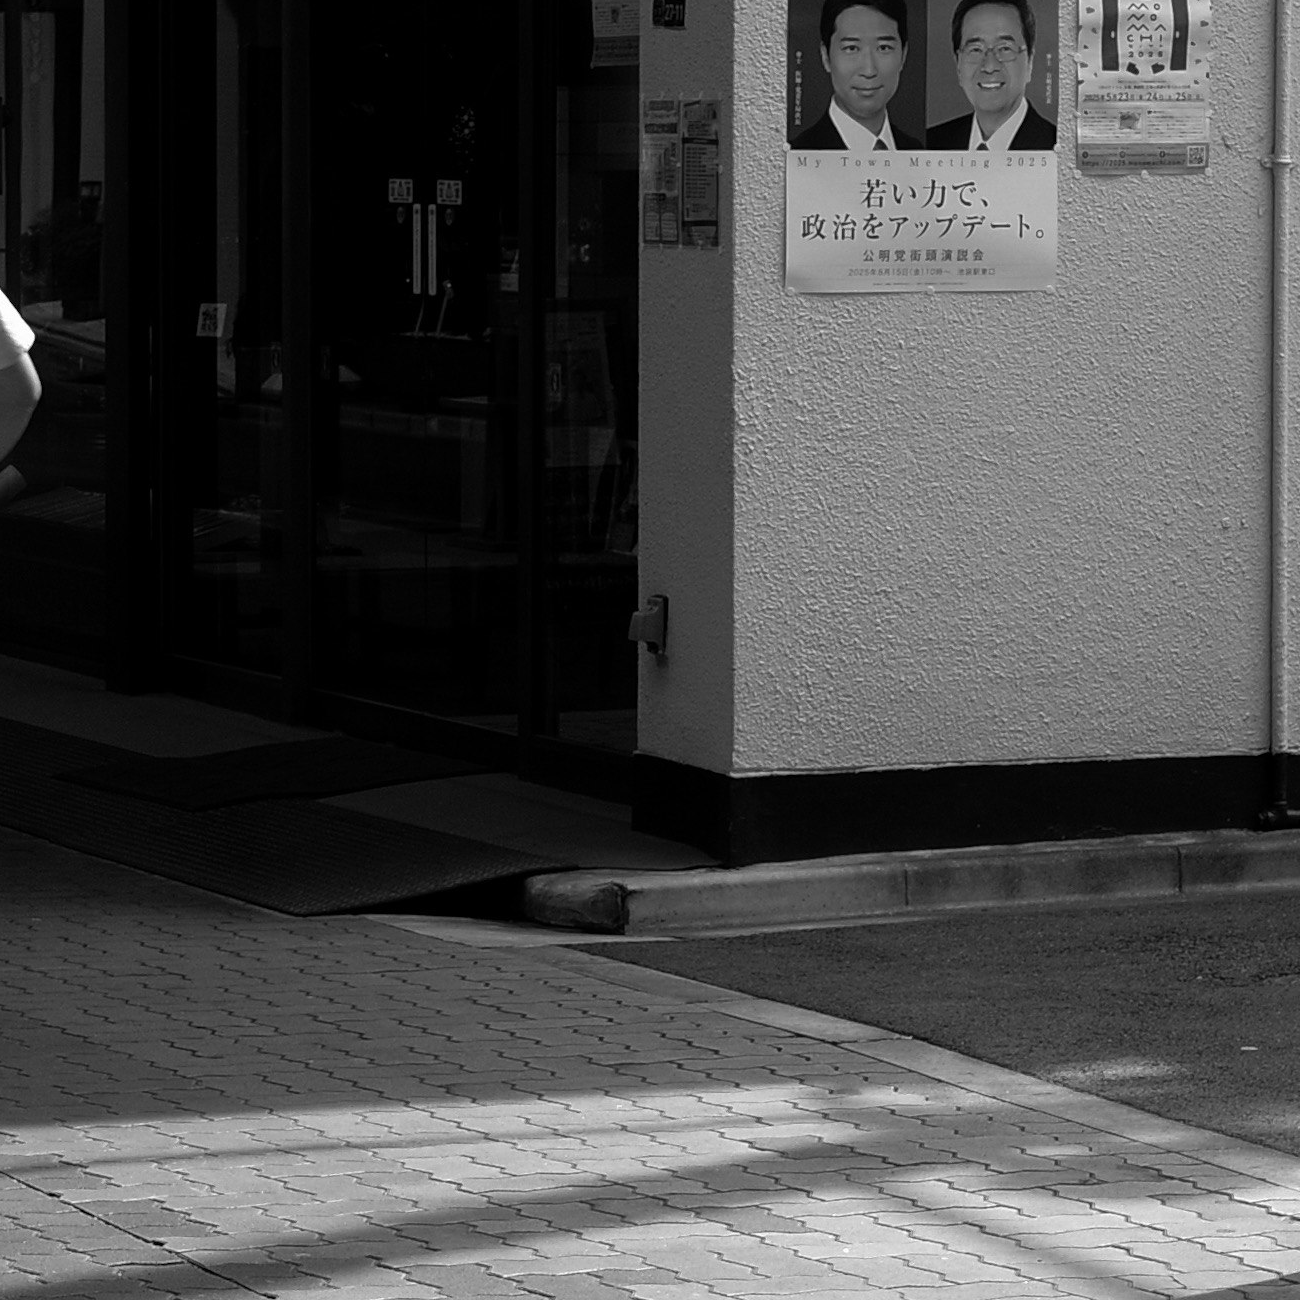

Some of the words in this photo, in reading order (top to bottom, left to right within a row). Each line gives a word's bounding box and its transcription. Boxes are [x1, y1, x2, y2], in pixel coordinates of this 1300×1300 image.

[797, 156, 822, 169] My
[841, 156, 892, 168] Town
[909, 156, 991, 169] Meeting
[1006, 156, 1048, 168] 2025
[860, 178, 989, 209] 若い力で、
[801, 212, 1045, 242] 政治をアップデート。
[862, 248, 985, 263] 公明党街頭演説会
